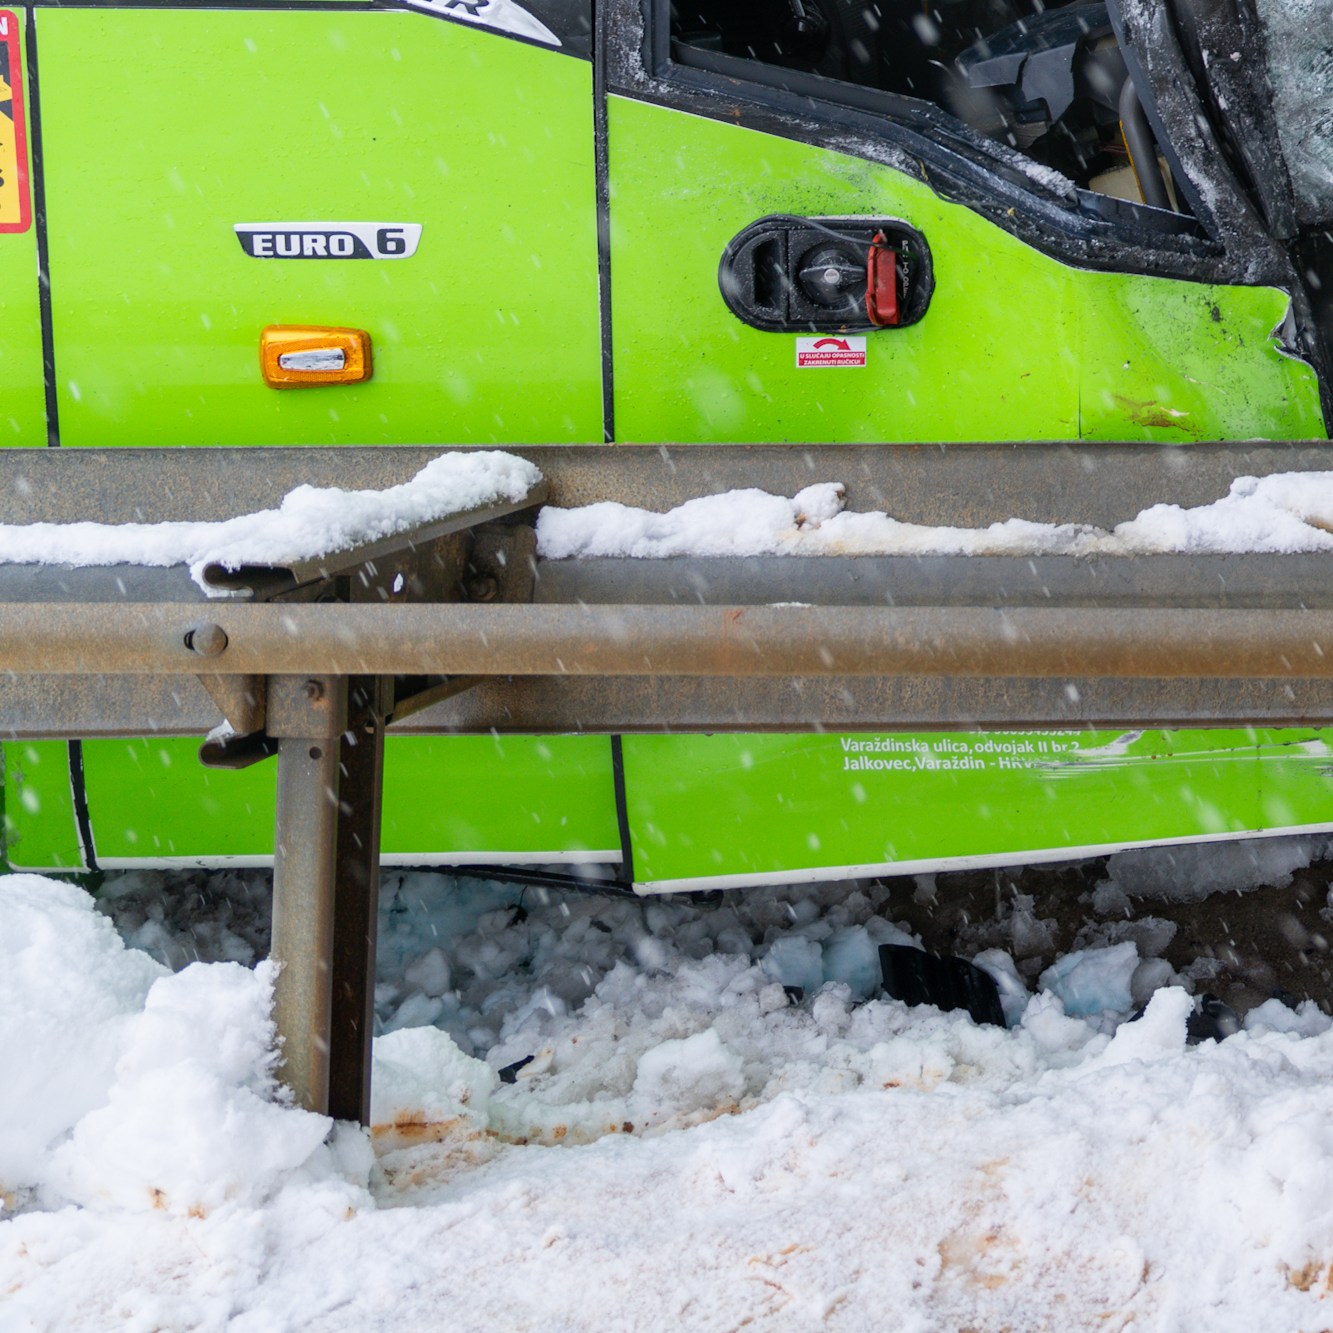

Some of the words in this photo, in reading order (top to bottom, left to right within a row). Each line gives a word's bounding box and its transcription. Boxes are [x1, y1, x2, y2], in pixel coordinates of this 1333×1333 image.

[252, 233, 354, 257] EURO
[377, 228, 406, 256] 6
[840, 737, 930, 753] Varaždinska
